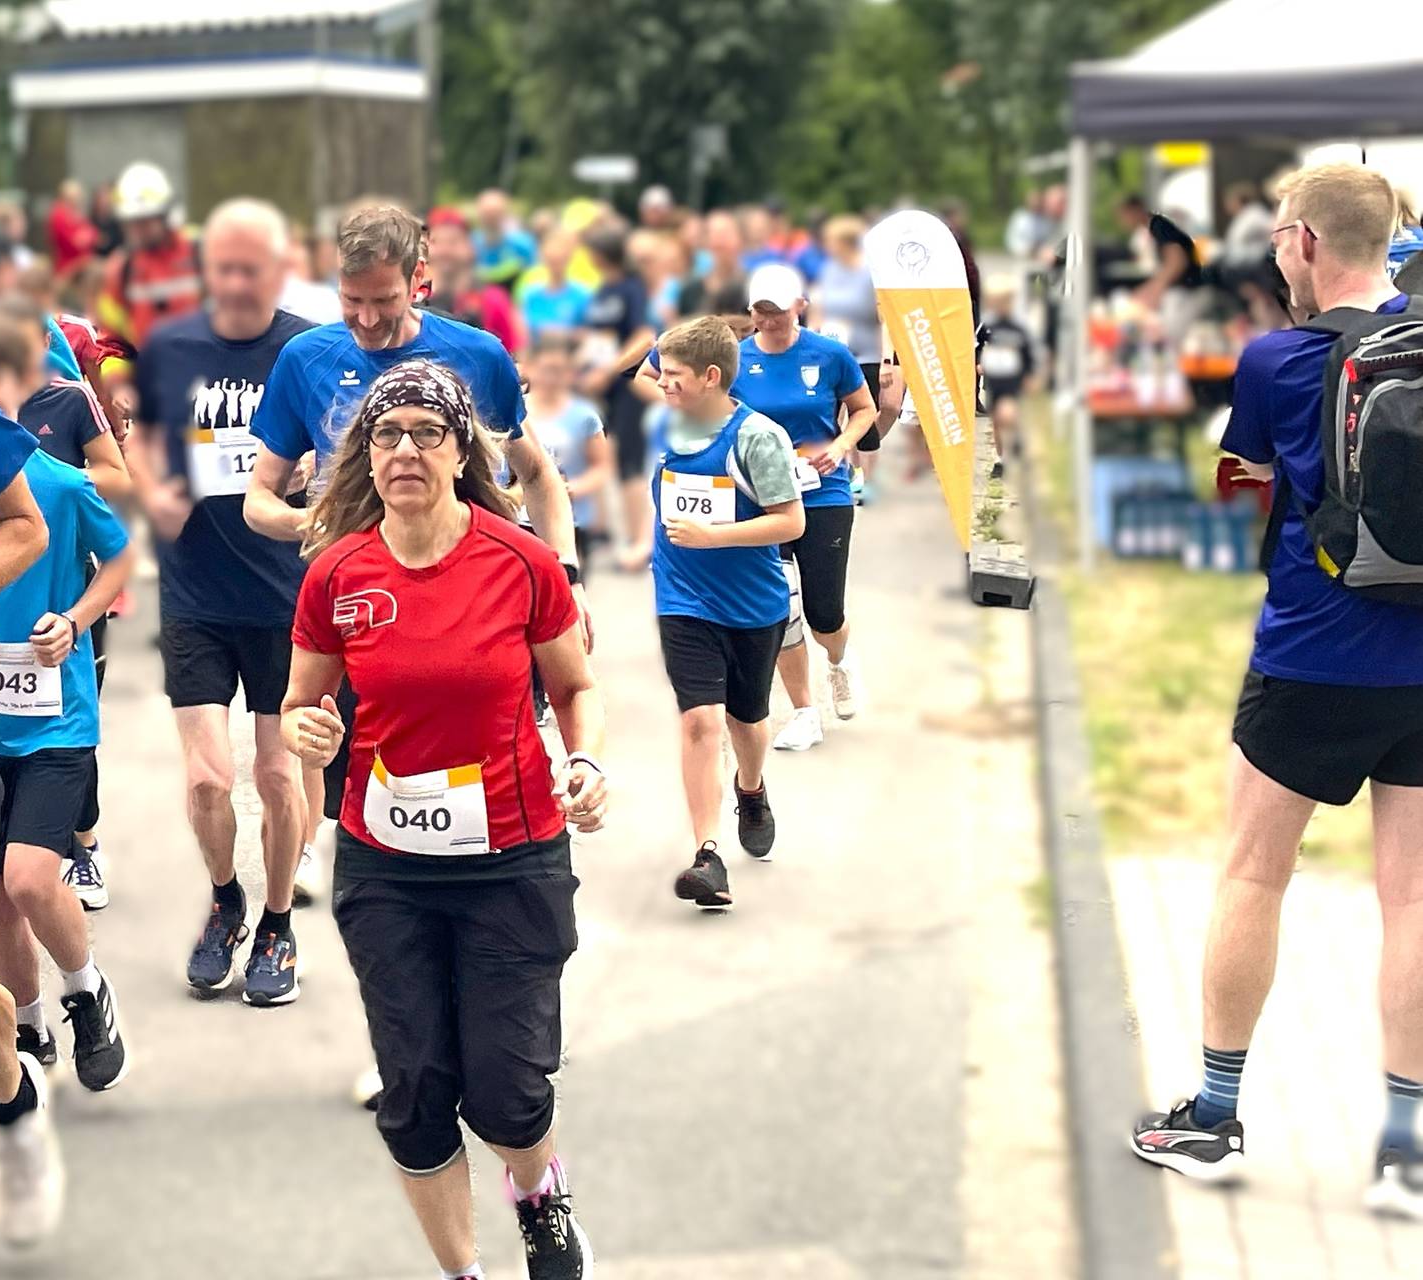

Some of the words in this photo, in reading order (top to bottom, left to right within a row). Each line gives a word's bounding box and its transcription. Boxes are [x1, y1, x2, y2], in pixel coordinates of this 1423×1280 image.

[910, 307, 966, 446] FÖRDERVEREIN
[677, 496, 712, 514] 078
[389, 806, 451, 831] 040
